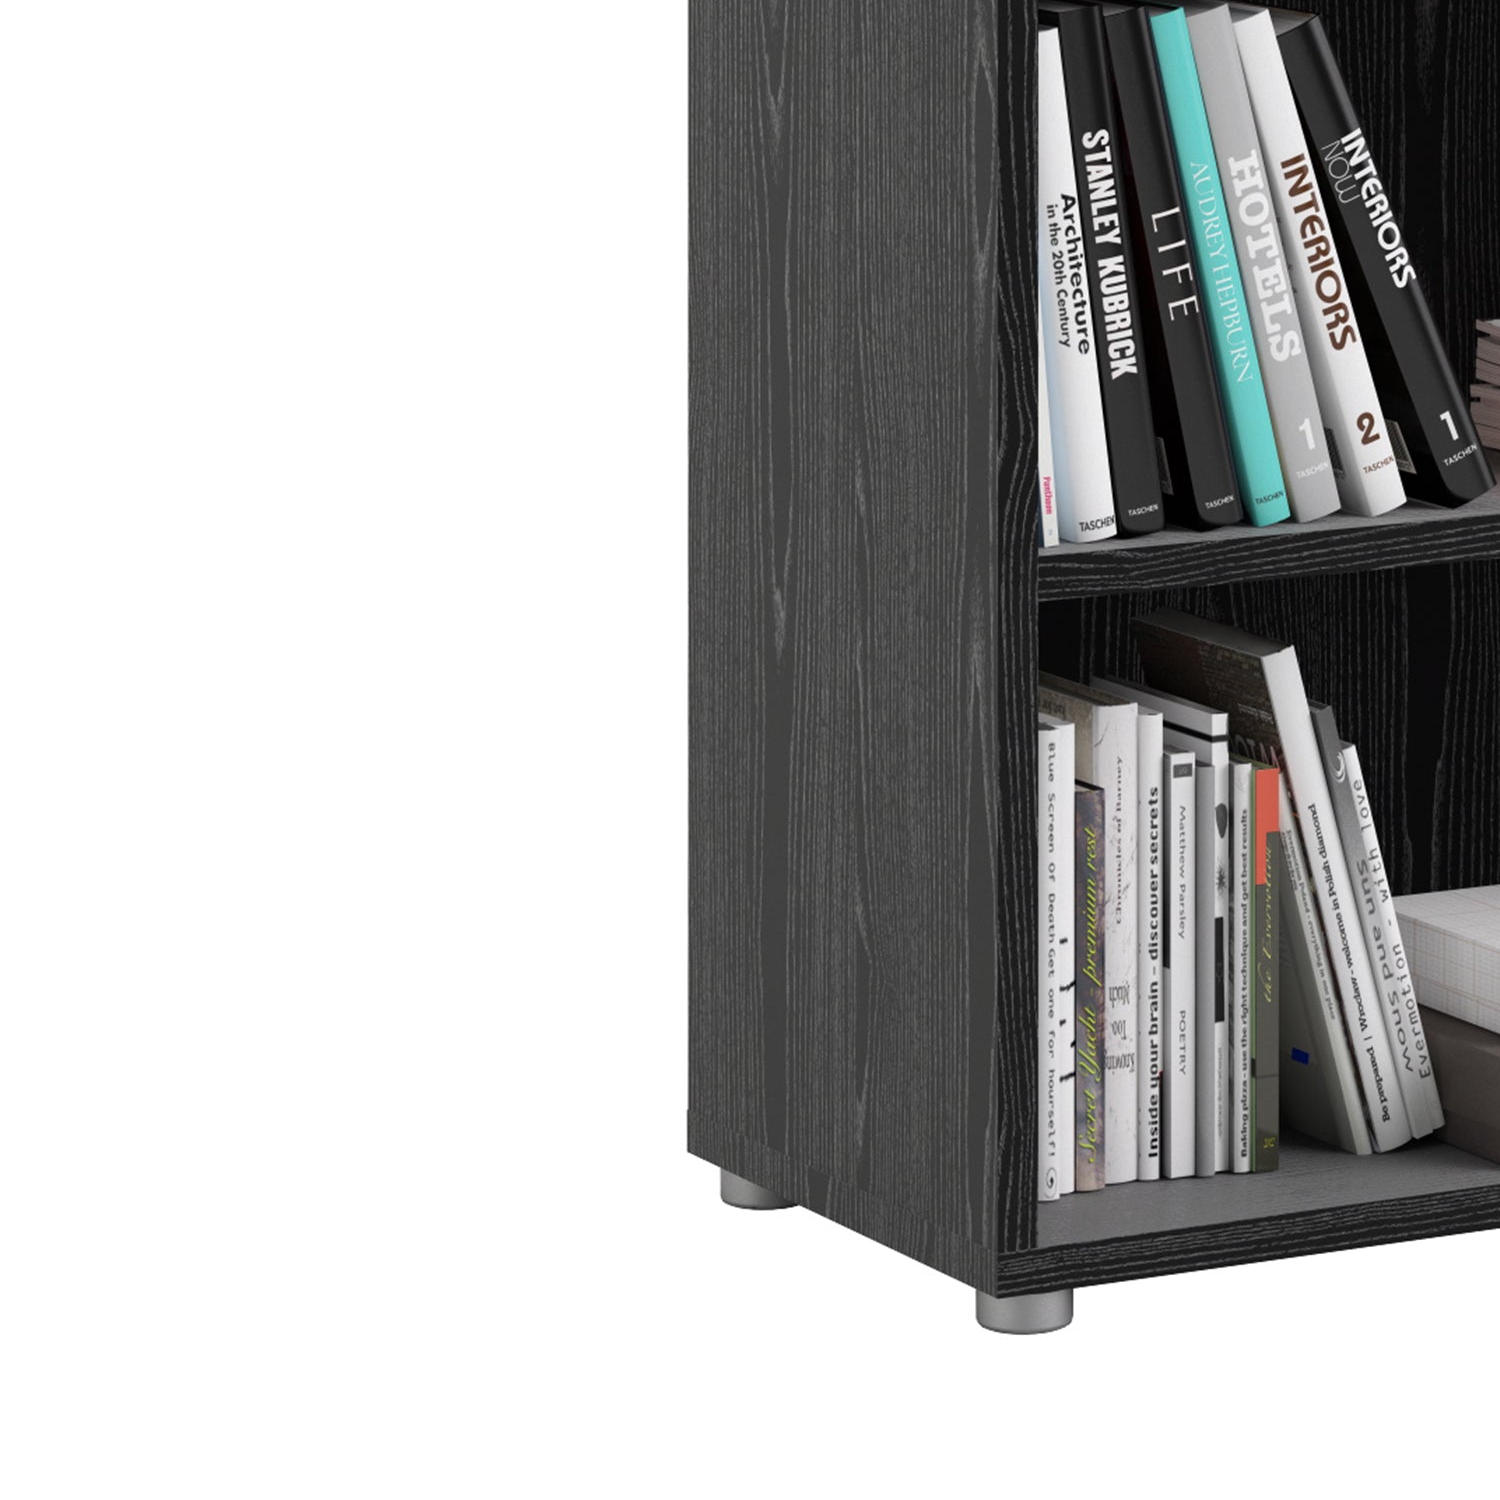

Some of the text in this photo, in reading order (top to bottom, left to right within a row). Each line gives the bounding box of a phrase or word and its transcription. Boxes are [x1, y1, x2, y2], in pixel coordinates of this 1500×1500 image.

[1321, 139, 1361, 204] NOW
[1341, 129, 1417, 288] INTERIORS
[1046, 204, 1072, 348] in the 20th Century
[1061, 193, 1090, 355] Architecture
[1081, 129, 1138, 380] STANLEY KUBRICK
[1151, 206, 1199, 321] LIFE
[1190, 161, 1253, 383] AUDREY HEPBURN
[1228, 149, 1301, 362] HOTELS
[1280, 153, 1357, 351] INTERIORS
[1299, 418, 1316, 450] 1
[1356, 412, 1381, 445] 2
[1439, 410, 1459, 441] 1
[1296, 461, 1329, 478] TASCHEN
[1362, 455, 1394, 474] TASCHEN
[1443, 443, 1477, 467] TASCHEN
[1078, 515, 1115, 532] TASCHEN
[1128, 503, 1159, 516] TASCHEN
[1205, 494, 1234, 510] TASCHEN
[1255, 490, 1284, 505] TASCHEN
[1148, 787, 1159, 864] secrets
[1308, 803, 1328, 860] diamond
[1353, 779, 1372, 832] love
[1047, 742, 1056, 944] Blue Screen Of Death
[1083, 825, 1097, 872] rest
[1321, 860, 1336, 898] Polish
[1367, 847, 1390, 904] with
[1083, 878, 1102, 987] premium
[1148, 869, 1159, 961] discover
[1178, 884, 1186, 939] Parsley
[1331, 898, 1340, 912] in
[1048, 947, 1056, 977] Get
[1334, 912, 1353, 969] welcome
[1372, 925, 1394, 981] and
[1047, 988, 1055, 1019] one
[1148, 981, 1158, 1036] brain
[1392, 943, 1431, 1079] Evermotion
[1078, 1006, 1101, 1082] Yacht
[1149, 1039, 1160, 1088] your
[1240, 1080, 1248, 1111] pizza
[1366, 1045, 1388, 1106] prepared
[1079, 1089, 1097, 1164] Secret
[1148, 1093, 1159, 1158] Inside
[1381, 1106, 1390, 1122] Be
